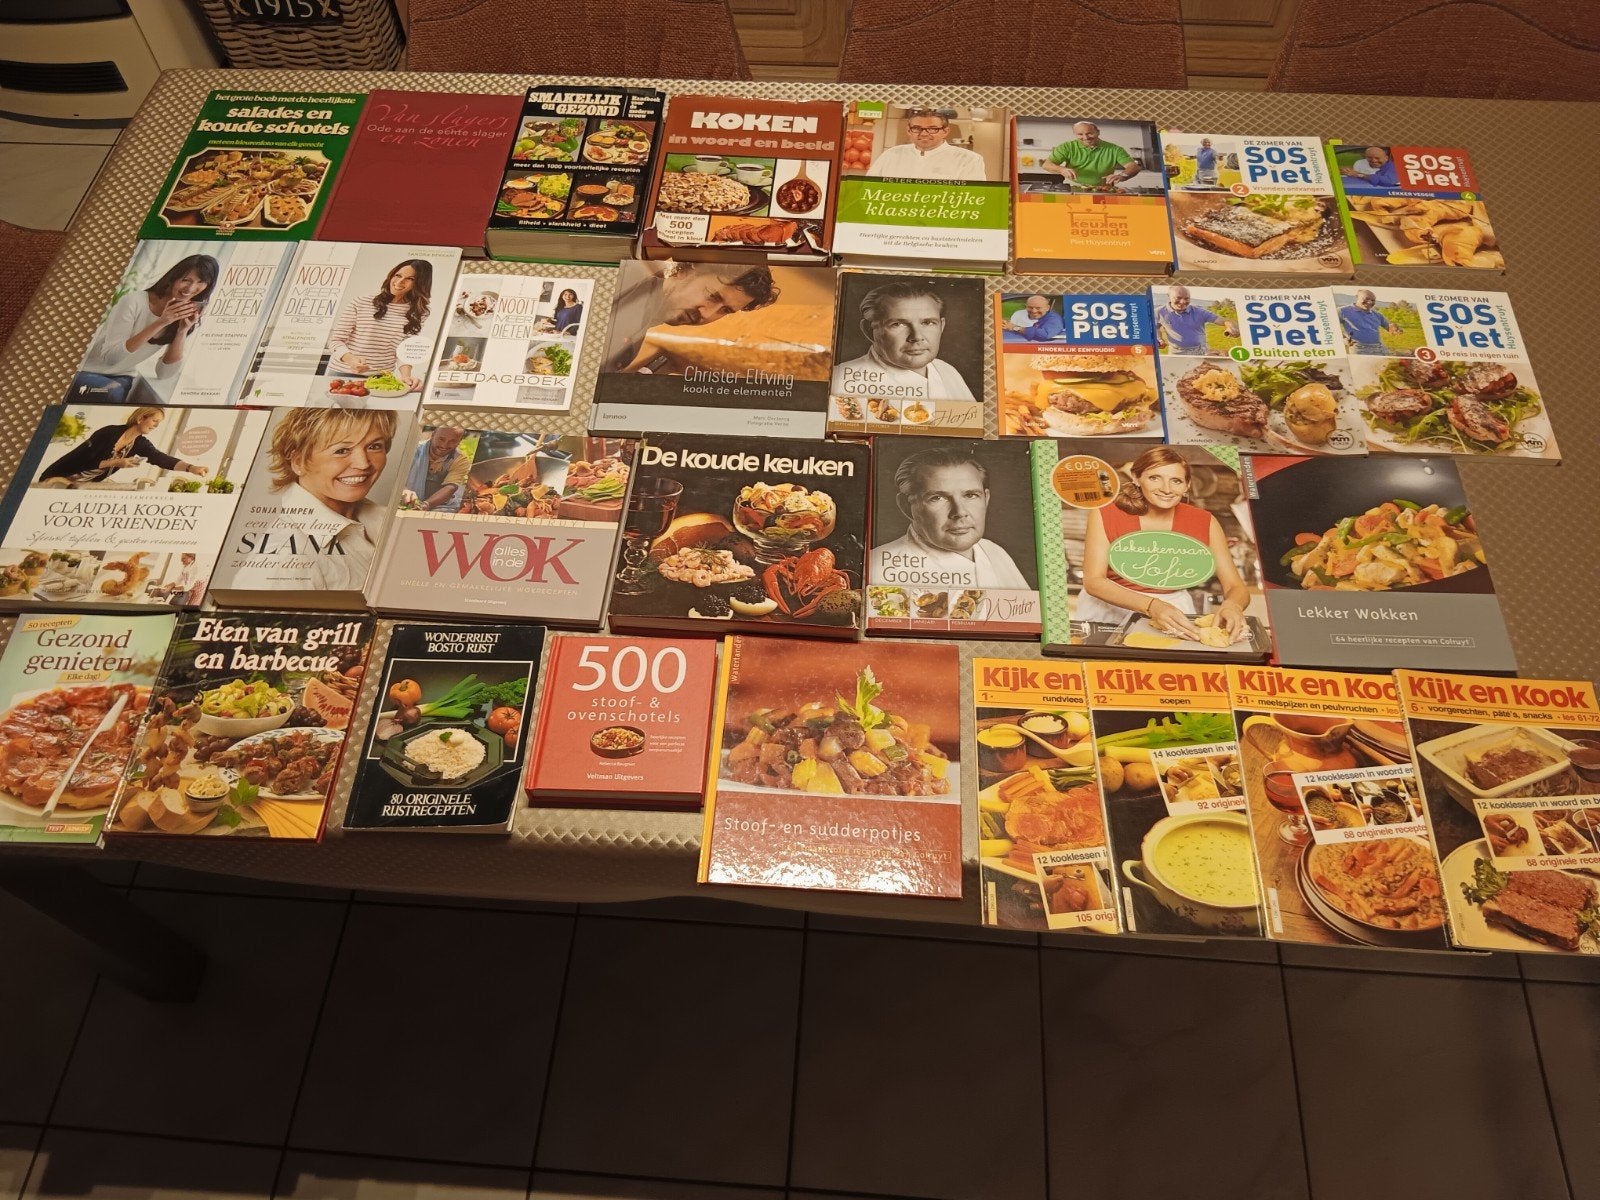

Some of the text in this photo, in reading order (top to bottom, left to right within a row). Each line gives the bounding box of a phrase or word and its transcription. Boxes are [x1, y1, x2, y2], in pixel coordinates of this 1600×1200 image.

[528, 92, 622, 106] SMAKELIJK
[226, 106, 332, 120] salades en
[556, 104, 620, 116] GEZOND
[197, 119, 350, 135] koude schotels
[367, 124, 391, 132] Ode
[472, 130, 508, 138] slager
[690, 112, 818, 134] KOKEN
[668, 134, 835, 151] in woord en beeld
[1244, 146, 1307, 164] SOS
[1403, 154, 1456, 171] SOS
[1248, 165, 1313, 183] Piet
[1407, 170, 1461, 187] Piet
[861, 188, 985, 209] Meesterlijke
[865, 202, 980, 220] klassiekers
[669, 221, 693, 230] 500
[223, 266, 272, 286] NOOIT
[296, 266, 349, 286] NOOIT
[218, 288, 266, 298] MEER
[291, 287, 341, 298] MEER
[210, 299, 262, 316] DIETEN
[497, 299, 536, 314] NOOIT
[1071, 302, 1127, 321] SOS
[1246, 302, 1316, 323] SOS
[1427, 302, 1497, 326] SOS
[495, 315, 534, 324] MEER
[1129, 303, 1140, 339] Huysentruyt
[1320, 300, 1334, 345] Huysentruyt
[1496, 304, 1517, 350] Huysentruyt
[492, 324, 531, 339] DIETEN
[1074, 322, 1129, 339] Piet
[1250, 325, 1321, 346] Piet
[1432, 325, 1505, 349] Piet
[1254, 348, 1335, 358] Buiten eten
[1440, 350, 1451, 358] Op
[438, 372, 567, 386] EETDAGBOEK
[684, 365, 794, 389] Christer Elfving
[843, 368, 885, 382] Peter
[682, 384, 792, 397] kookt de elementen
[844, 380, 923, 397] Goossens
[641, 446, 854, 476] De koude keuken
[48, 502, 202, 517] CLAUDIA KOOKT
[251, 506, 314, 515] SONJA KIMPEN
[42, 515, 197, 531] VOOR VRIENDEN
[245, 518, 342, 533] een leven lang
[236, 532, 350, 556] SLANK
[494, 547, 526, 557] alles
[231, 558, 314, 569] zonder dieet
[418, 529, 585, 585] WOK
[492, 558, 524, 568] in de
[881, 551, 927, 568] Peter
[883, 566, 972, 585] Goossens
[1121, 554, 1198, 586] Sofie
[976, 597, 1034, 626] Winter
[1298, 607, 1418, 621] Lekker Wokken
[40, 620, 72, 629] recepten
[37, 629, 132, 648] Gezond
[192, 618, 362, 650] Eten van grill
[425, 632, 501, 643] WONDERRIJST
[1348, 635, 1382, 644] heerlijke
[428, 643, 495, 653] BOSTO RIJST
[23, 652, 133, 675] genieten
[194, 646, 340, 672] en barbecue
[572, 646, 686, 694] 500
[983, 667, 1082, 692] Kijk en
[1096, 669, 1197, 694] Kijk en
[1237, 670, 1340, 697] Kijk en
[1043, 695, 1083, 704] rundvlees
[1094, 695, 1107, 704] 12
[1408, 676, 1590, 709] Kijk en Kook
[592, 696, 660, 708] stoof- &
[1236, 695, 1250, 704] 31
[1258, 699, 1308, 709] meelspijzen
[1322, 702, 1378, 713] peulvruchten
[1412, 703, 1418, 711] 6
[1428, 705, 1491, 717] voorgerechten,
[568, 710, 680, 723] ovenschotels
[1317, 772, 1366, 782] kooklessen
[1366, 770, 1375, 778] in
[1377, 768, 1403, 776] woord
[390, 794, 472, 804] 80 ORIGINELE
[1490, 800, 1538, 809] kooklessen
[382, 805, 476, 816] RIJSTRECEPTEN
[725, 817, 921, 844] Stoof- en sudderpotjes
[1344, 827, 1393, 841] 88 originele
